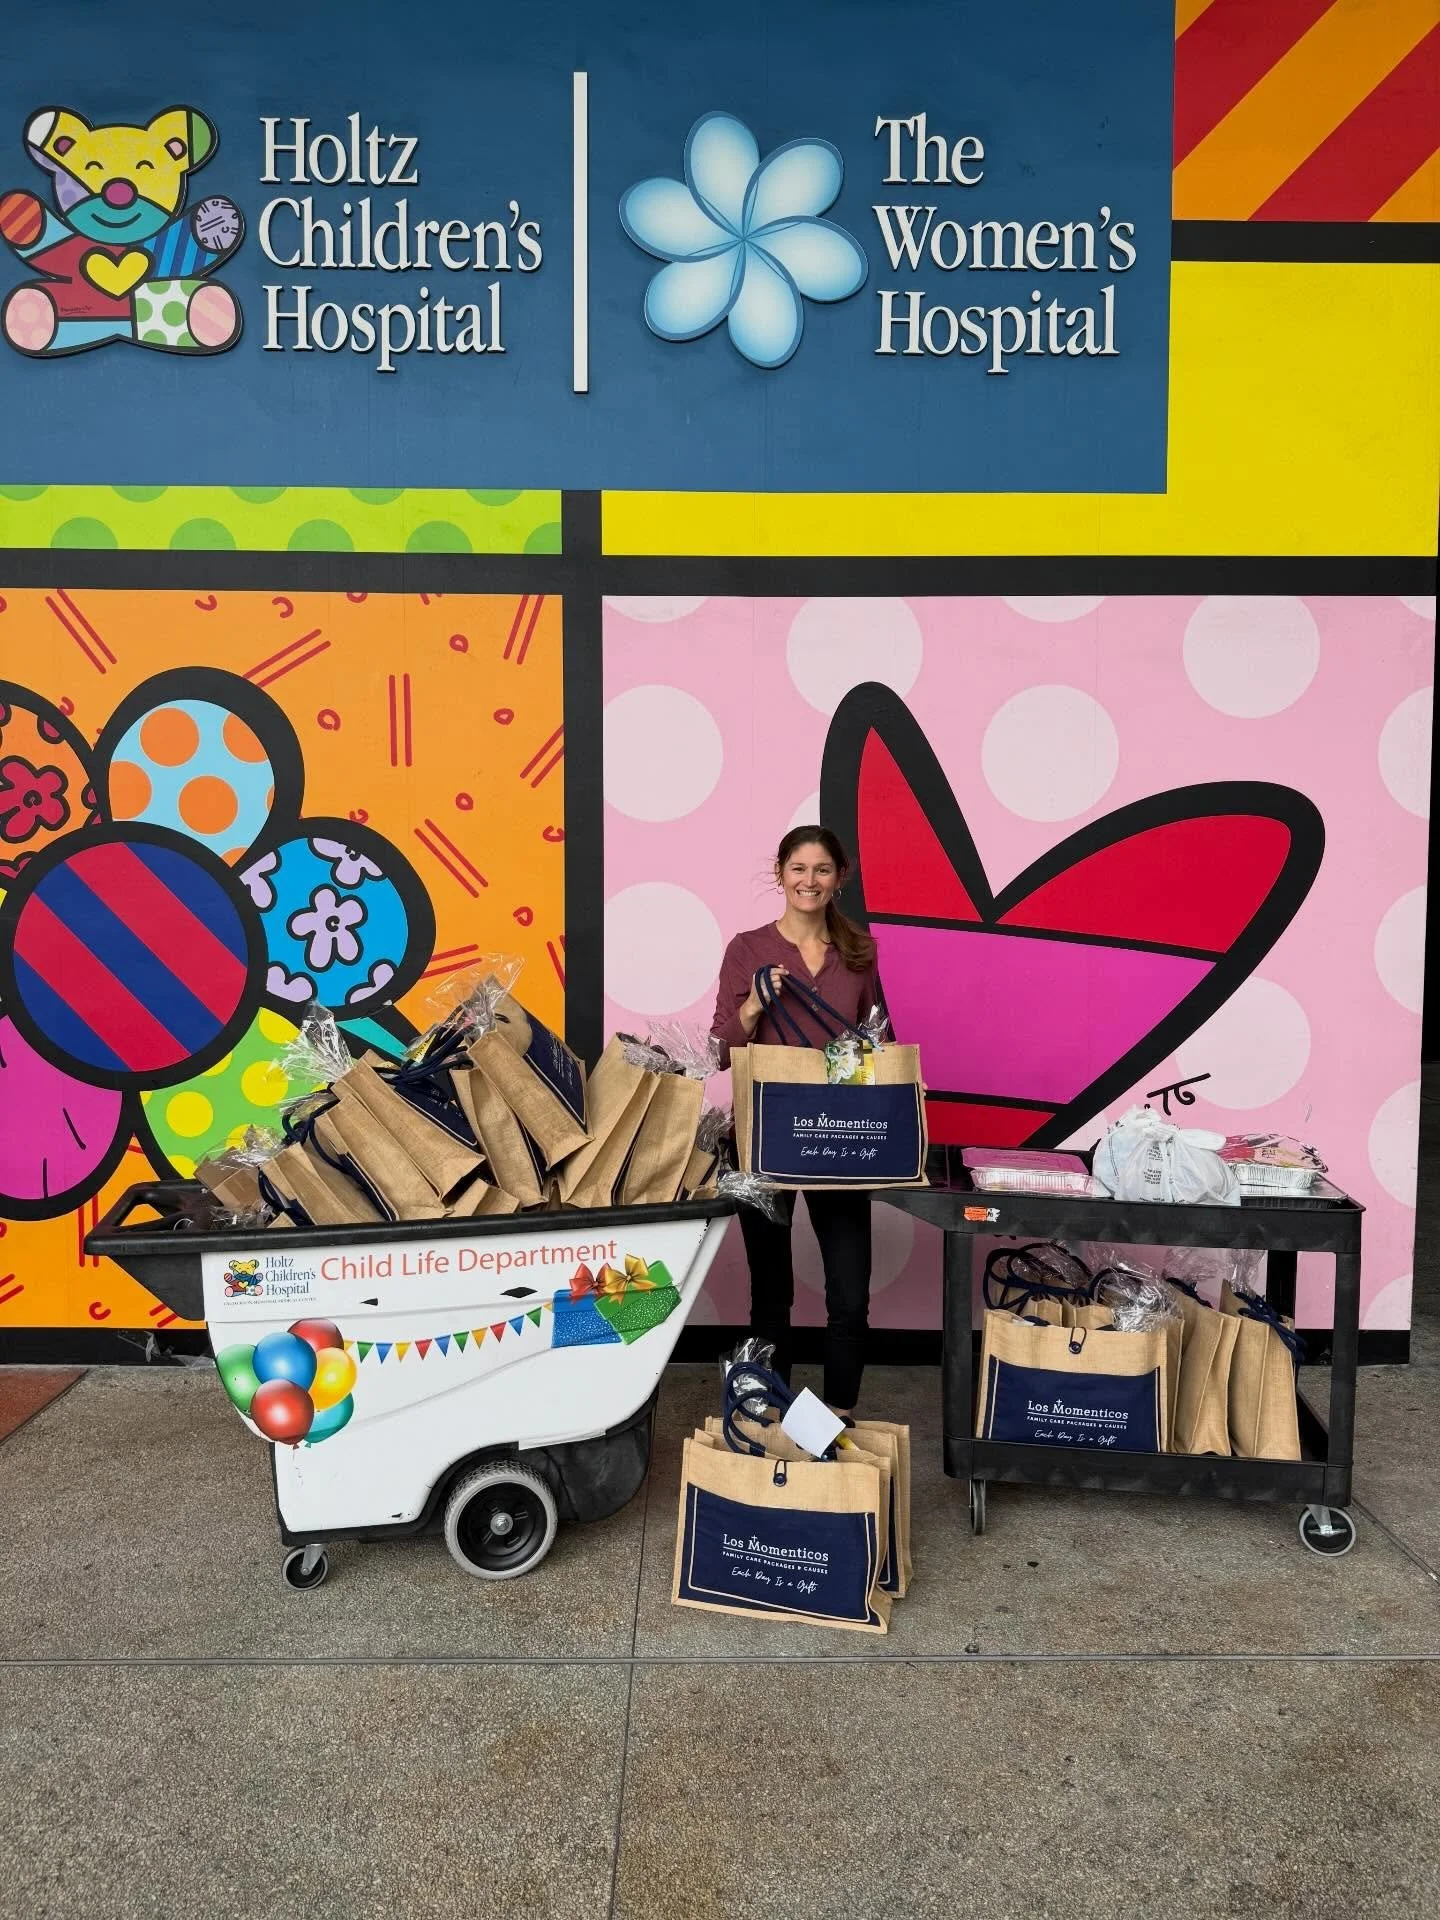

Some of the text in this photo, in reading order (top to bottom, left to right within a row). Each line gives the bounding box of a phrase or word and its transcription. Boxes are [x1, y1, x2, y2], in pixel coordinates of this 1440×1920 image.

[259, 112, 419, 185] Holtz
[873, 112, 985, 185] The
[258, 196, 543, 271] Children's
[872, 205, 1136, 272] Women's
[261, 281, 506, 372] Hospital
[874, 283, 1120, 375] Hospital
[793, 1116, 888, 1129] Los Momenticos
[266, 1255, 294, 1269] Holtz
[320, 1239, 617, 1281] Child Life Department
[265, 1268, 316, 1282] Children's
[266, 1281, 309, 1297] Hospital
[1026, 1415, 1047, 1423] FAMILY
[1066, 1420, 1097, 1428] PACKAGES
[1027, 1400, 1128, 1420] Los Momenticos
[723, 1533, 829, 1562] Los Momenticos
[722, 1551, 744, 1560] FAMILY
[745, 1555, 761, 1563] CARE
[763, 1559, 795, 1570] PACKAGES
[803, 1566, 828, 1575] CAUSES
